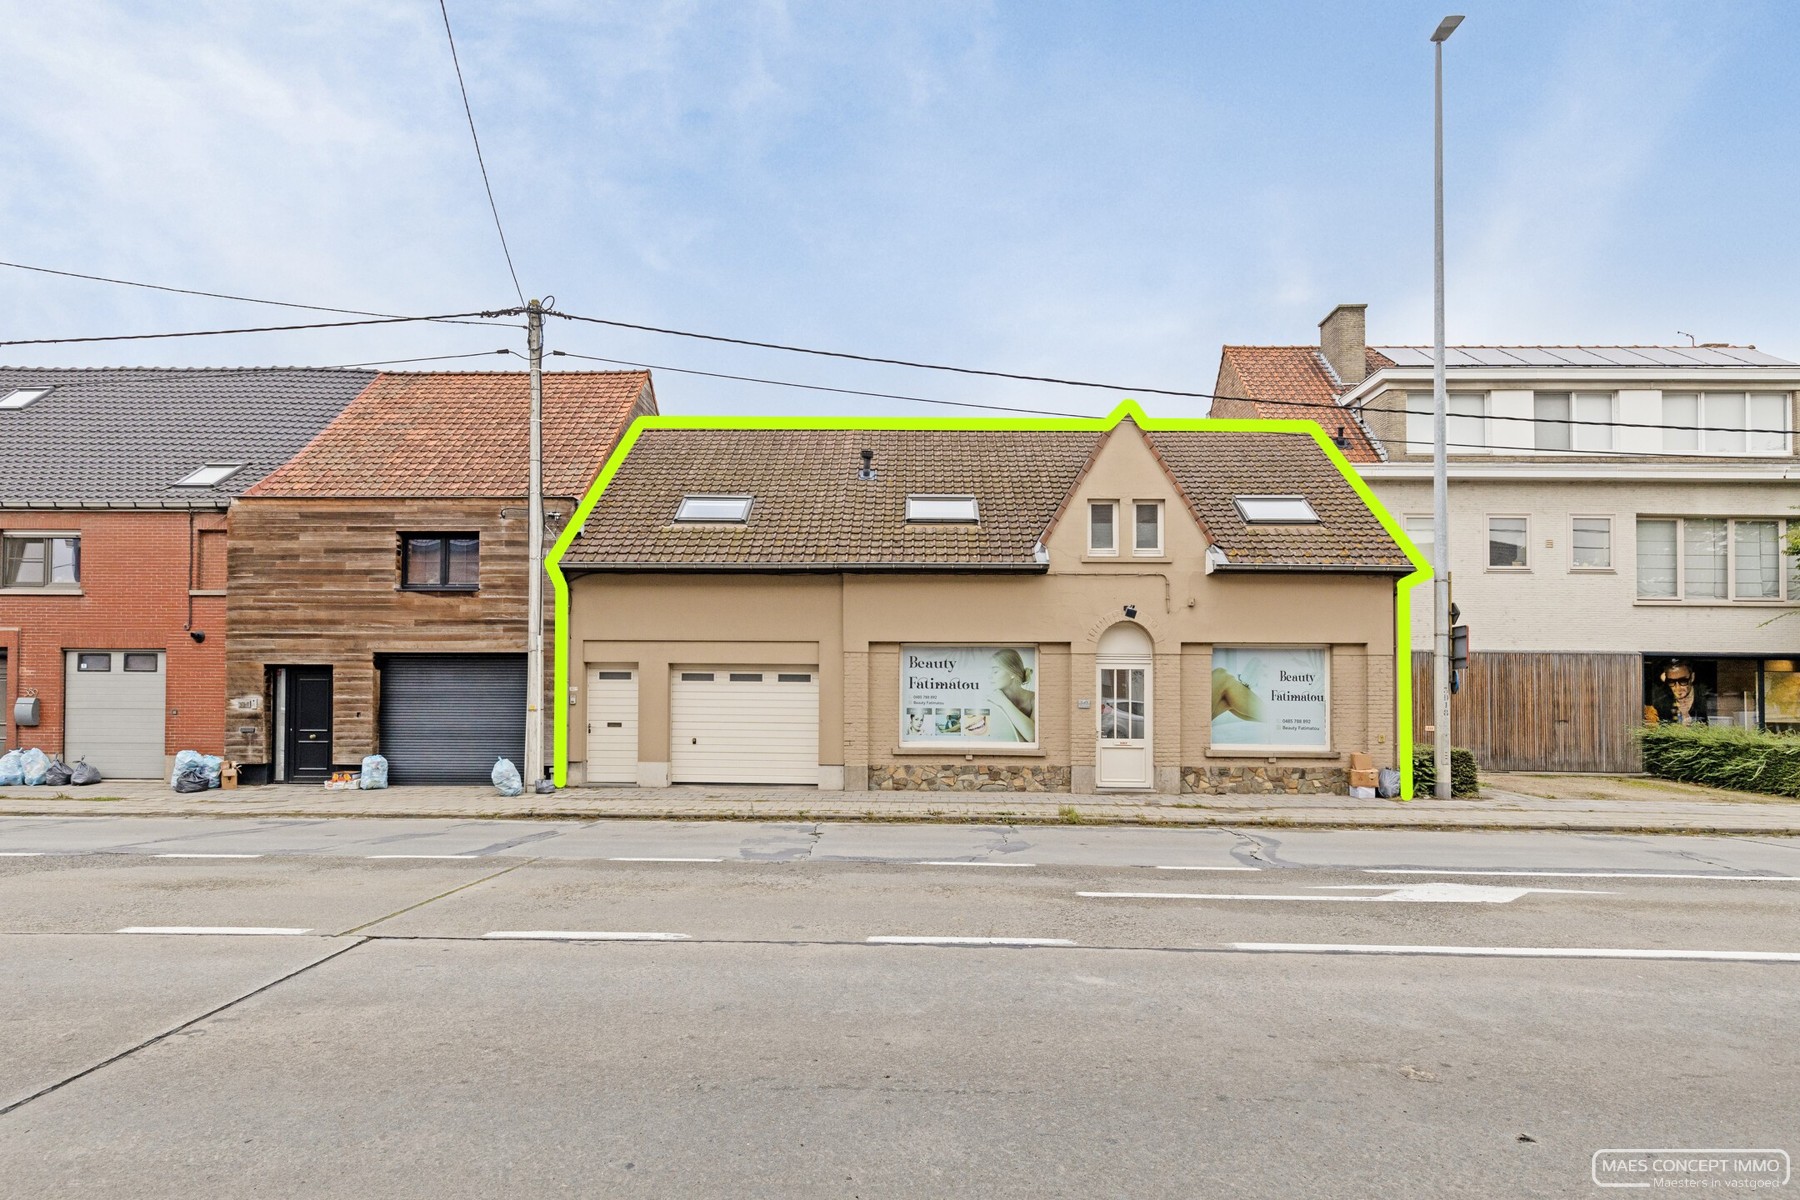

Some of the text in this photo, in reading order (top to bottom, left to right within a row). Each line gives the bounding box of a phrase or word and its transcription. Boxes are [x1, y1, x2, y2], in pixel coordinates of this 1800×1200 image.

[909, 655, 957, 673] Beauty
[909, 676, 980, 690] Fatimatou
[1280, 670, 1315, 686] Beauty
[1271, 689, 1324, 702] Fatimatou
